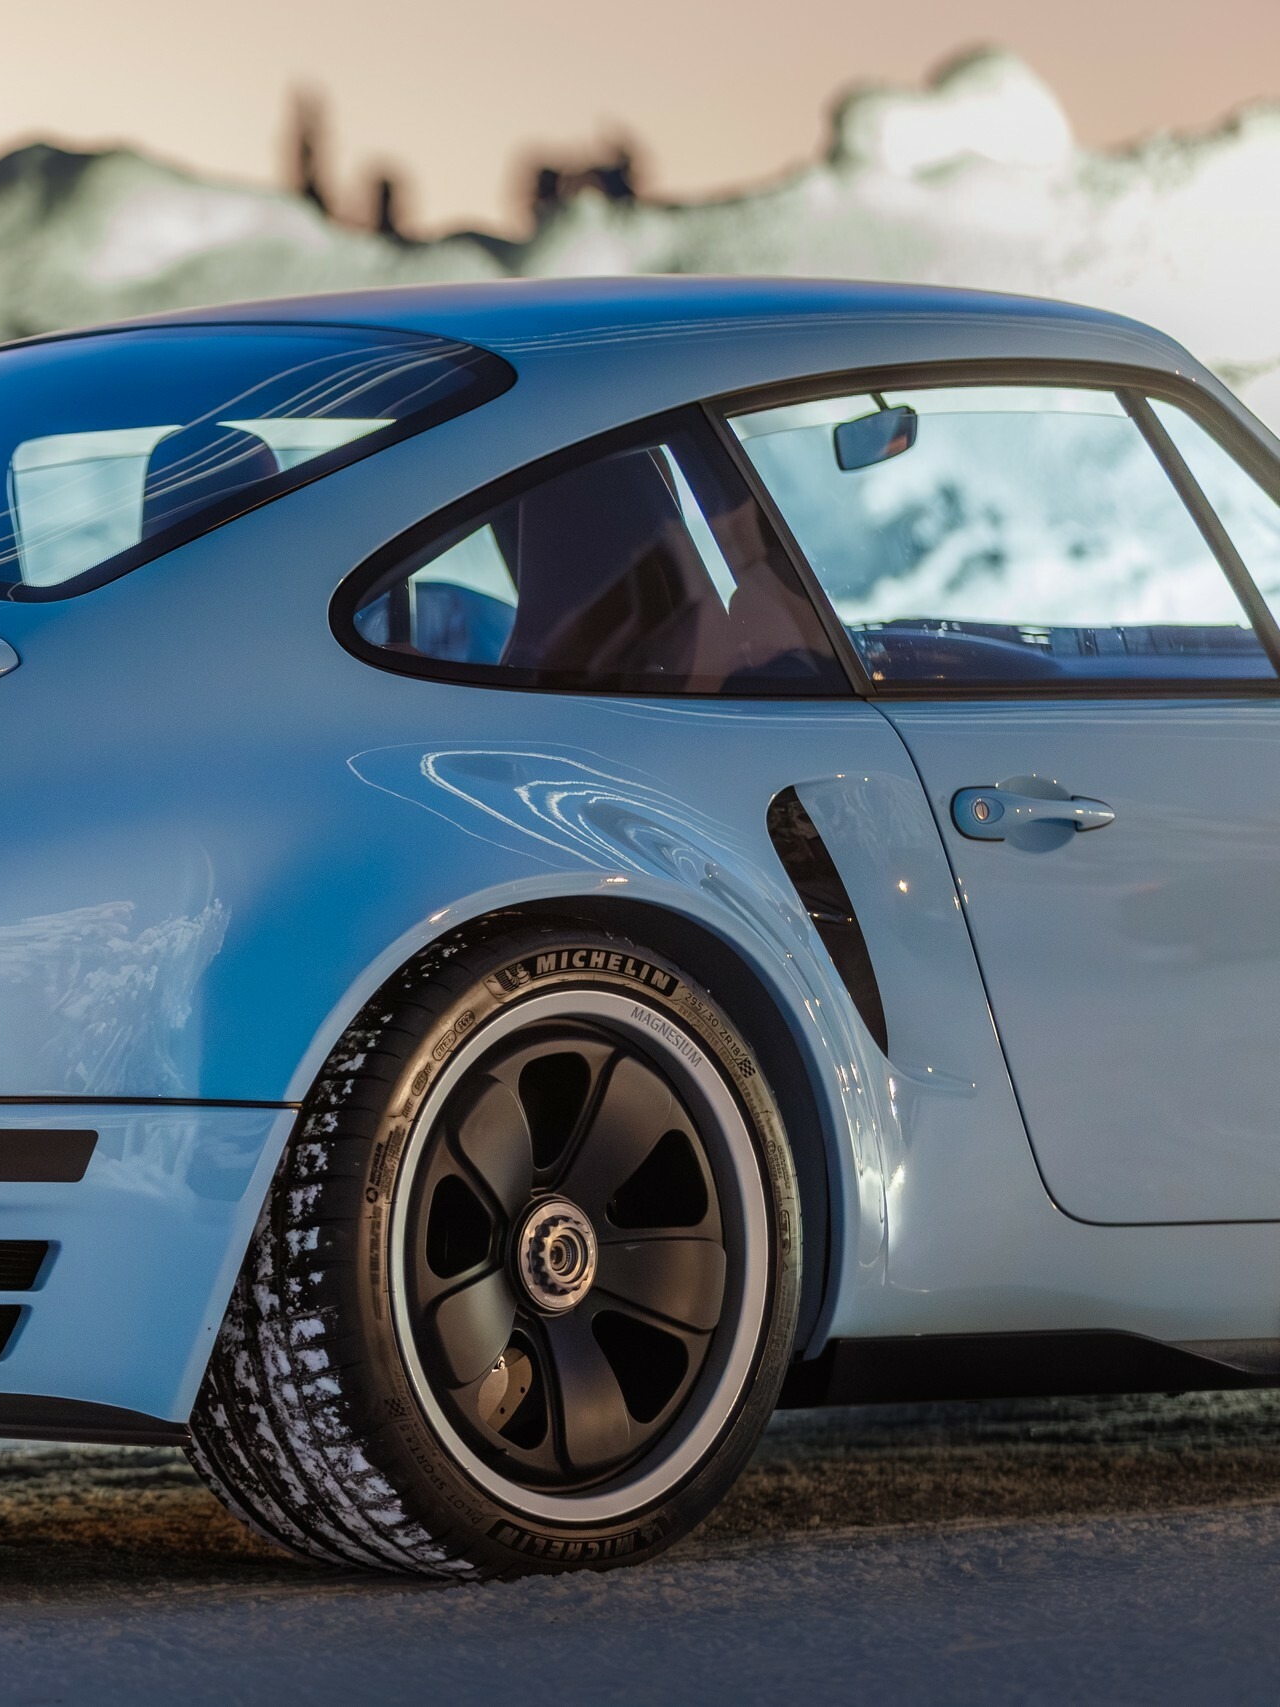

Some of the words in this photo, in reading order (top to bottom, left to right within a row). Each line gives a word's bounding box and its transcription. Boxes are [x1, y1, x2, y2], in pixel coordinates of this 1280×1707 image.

[536, 950, 670, 990] MICHELIN
[684, 992, 719, 1028] 295/30
[631, 1007, 702, 1068] MAGNESIUM
[411, 1447, 448, 1491] SPORT
[446, 1494, 484, 1525] PILOT
[496, 1526, 635, 1560] MICHELIN
